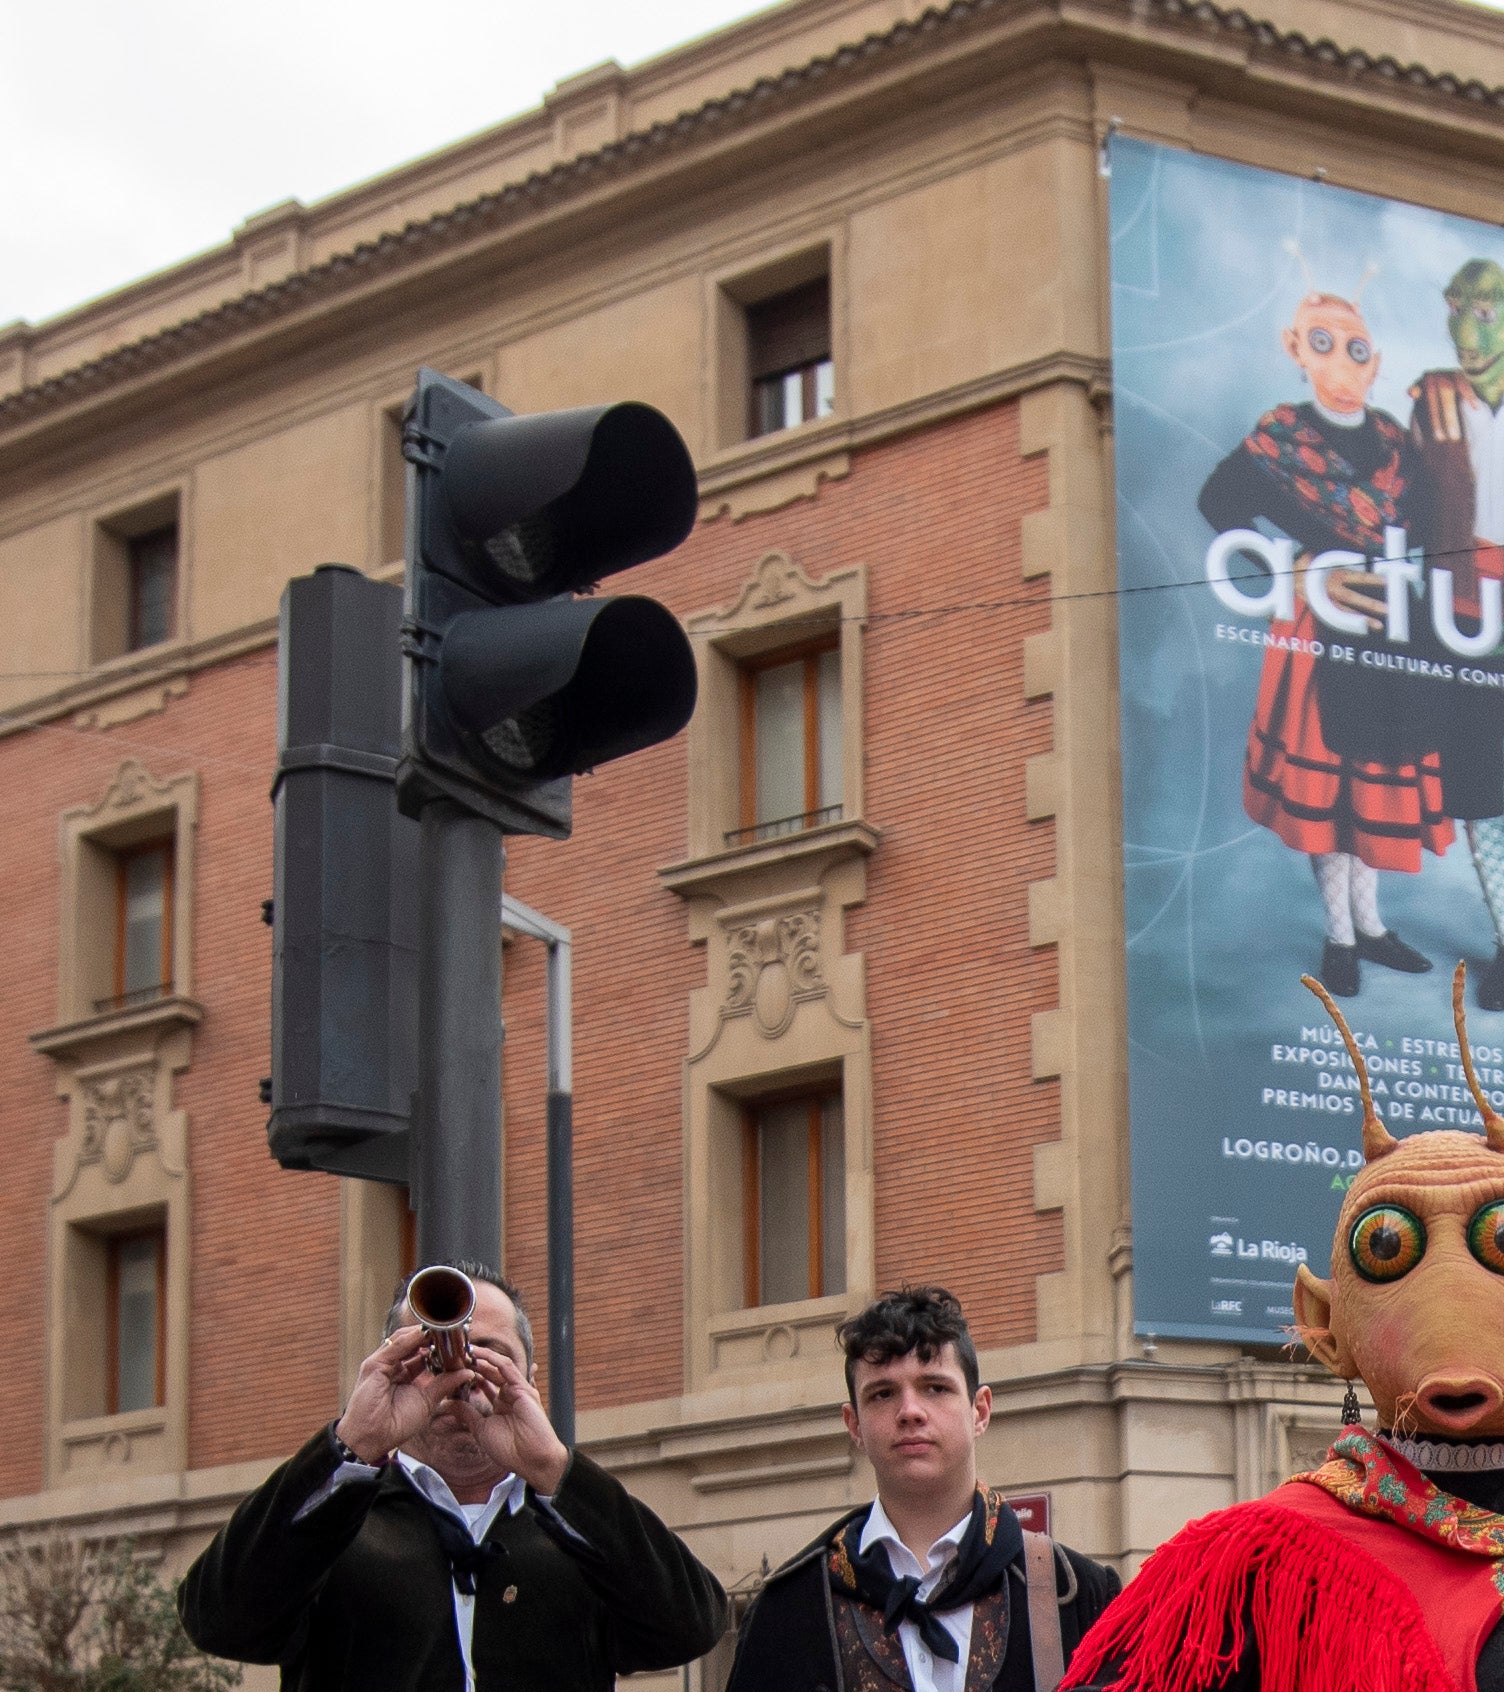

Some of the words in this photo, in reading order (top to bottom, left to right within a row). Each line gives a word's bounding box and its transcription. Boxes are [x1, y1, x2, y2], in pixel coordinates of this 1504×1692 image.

[1216, 623, 1325, 656] ESCENARIO
[1331, 644, 1354, 662] DE
[1361, 650, 1455, 679] CULTURAS
[1302, 1025, 1379, 1049] MÚSCA
[1263, 1088, 1354, 1112] PREMIOS
[1389, 1102, 1414, 1119] DE
[1222, 1137, 1346, 1168] LOGROÑO,
[1237, 1238, 1258, 1257] La
[1262, 1240, 1308, 1263] Rioja
